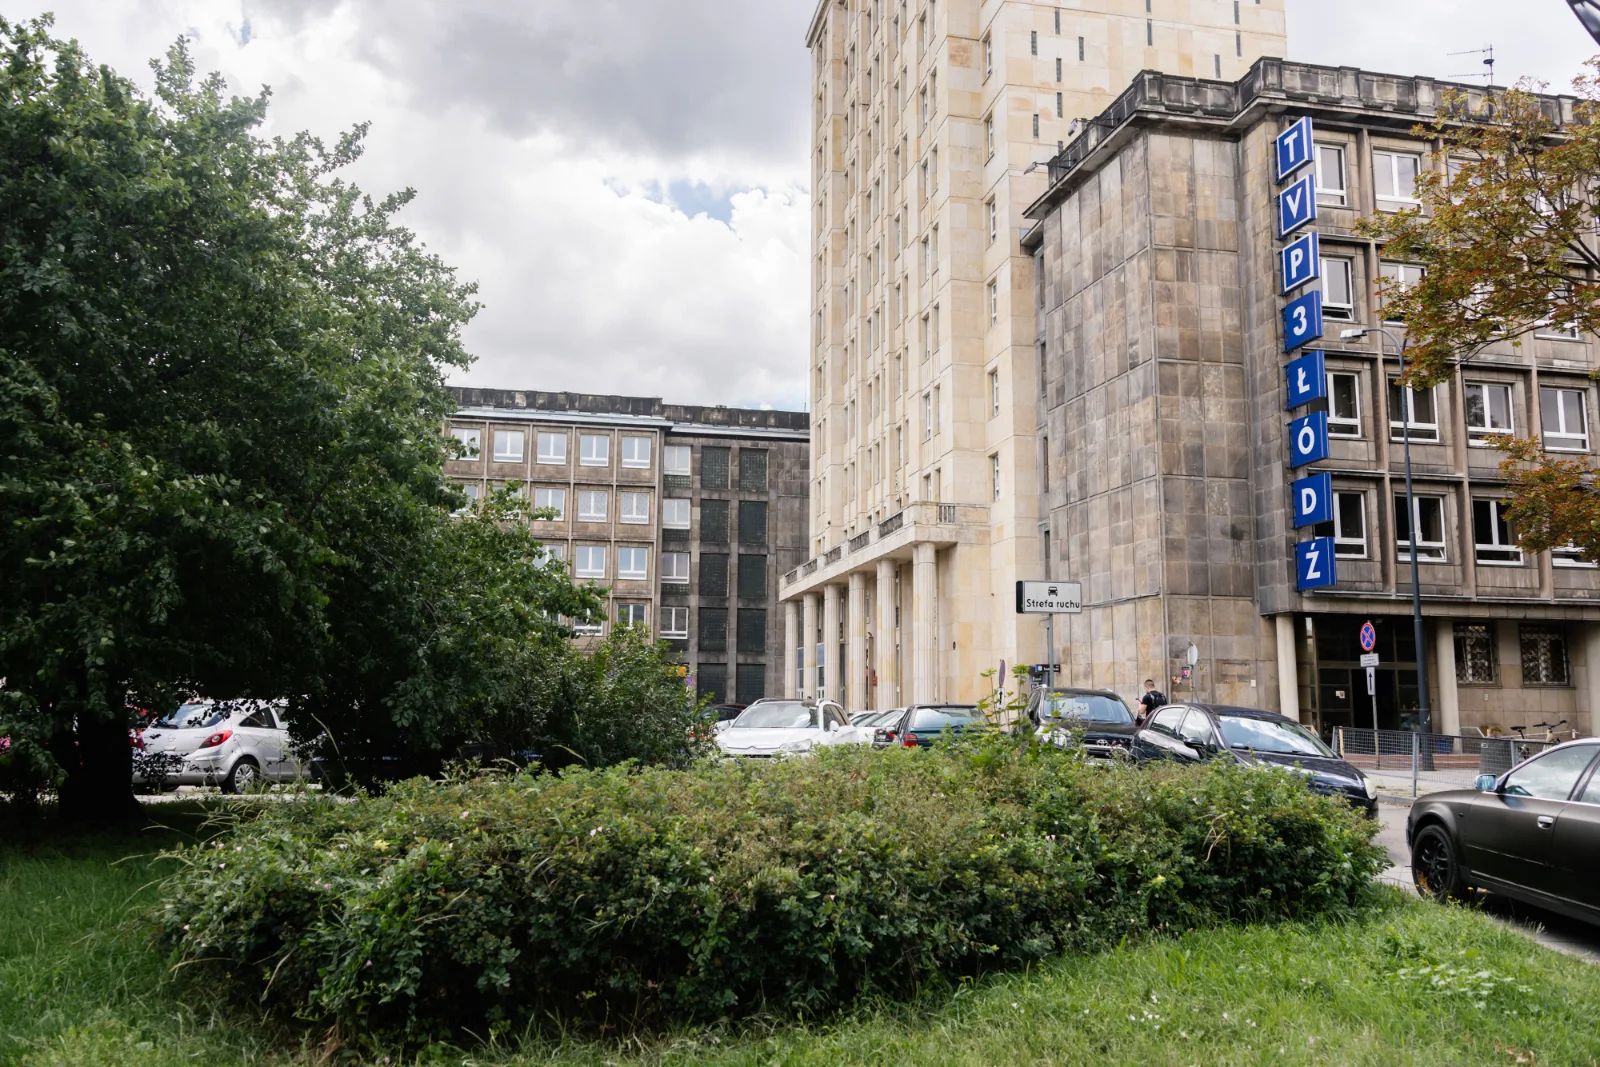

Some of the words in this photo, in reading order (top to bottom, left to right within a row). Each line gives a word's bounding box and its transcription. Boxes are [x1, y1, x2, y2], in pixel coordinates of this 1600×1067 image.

[1297, 366, 1321, 580] ŁÓDŹ
[1026, 598, 1054, 608] Strefa
[1056, 599, 1080, 609] ruchu
